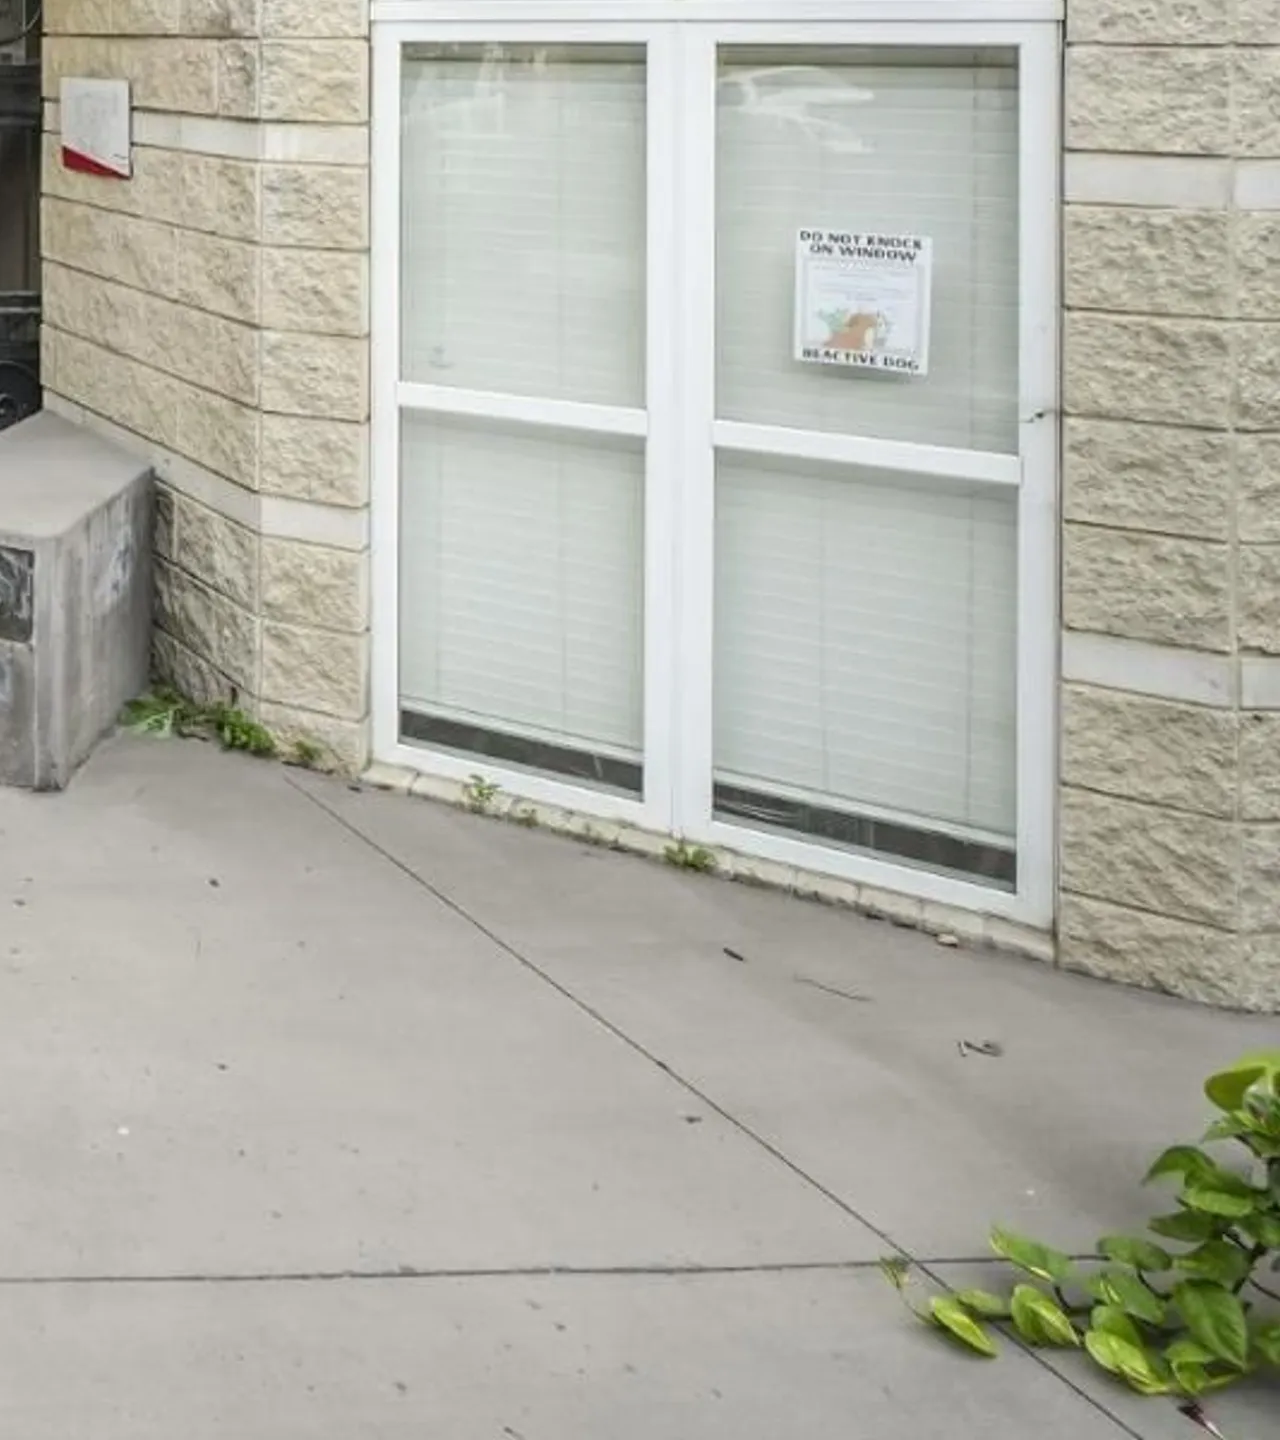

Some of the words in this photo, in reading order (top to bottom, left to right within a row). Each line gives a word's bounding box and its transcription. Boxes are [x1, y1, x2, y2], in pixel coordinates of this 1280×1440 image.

[799, 230, 823, 242] DO
[828, 233, 861, 245] NOT
[866, 235, 922, 250] KNOCK
[809, 244, 833, 255] ON
[839, 246, 917, 262] WINDOW
